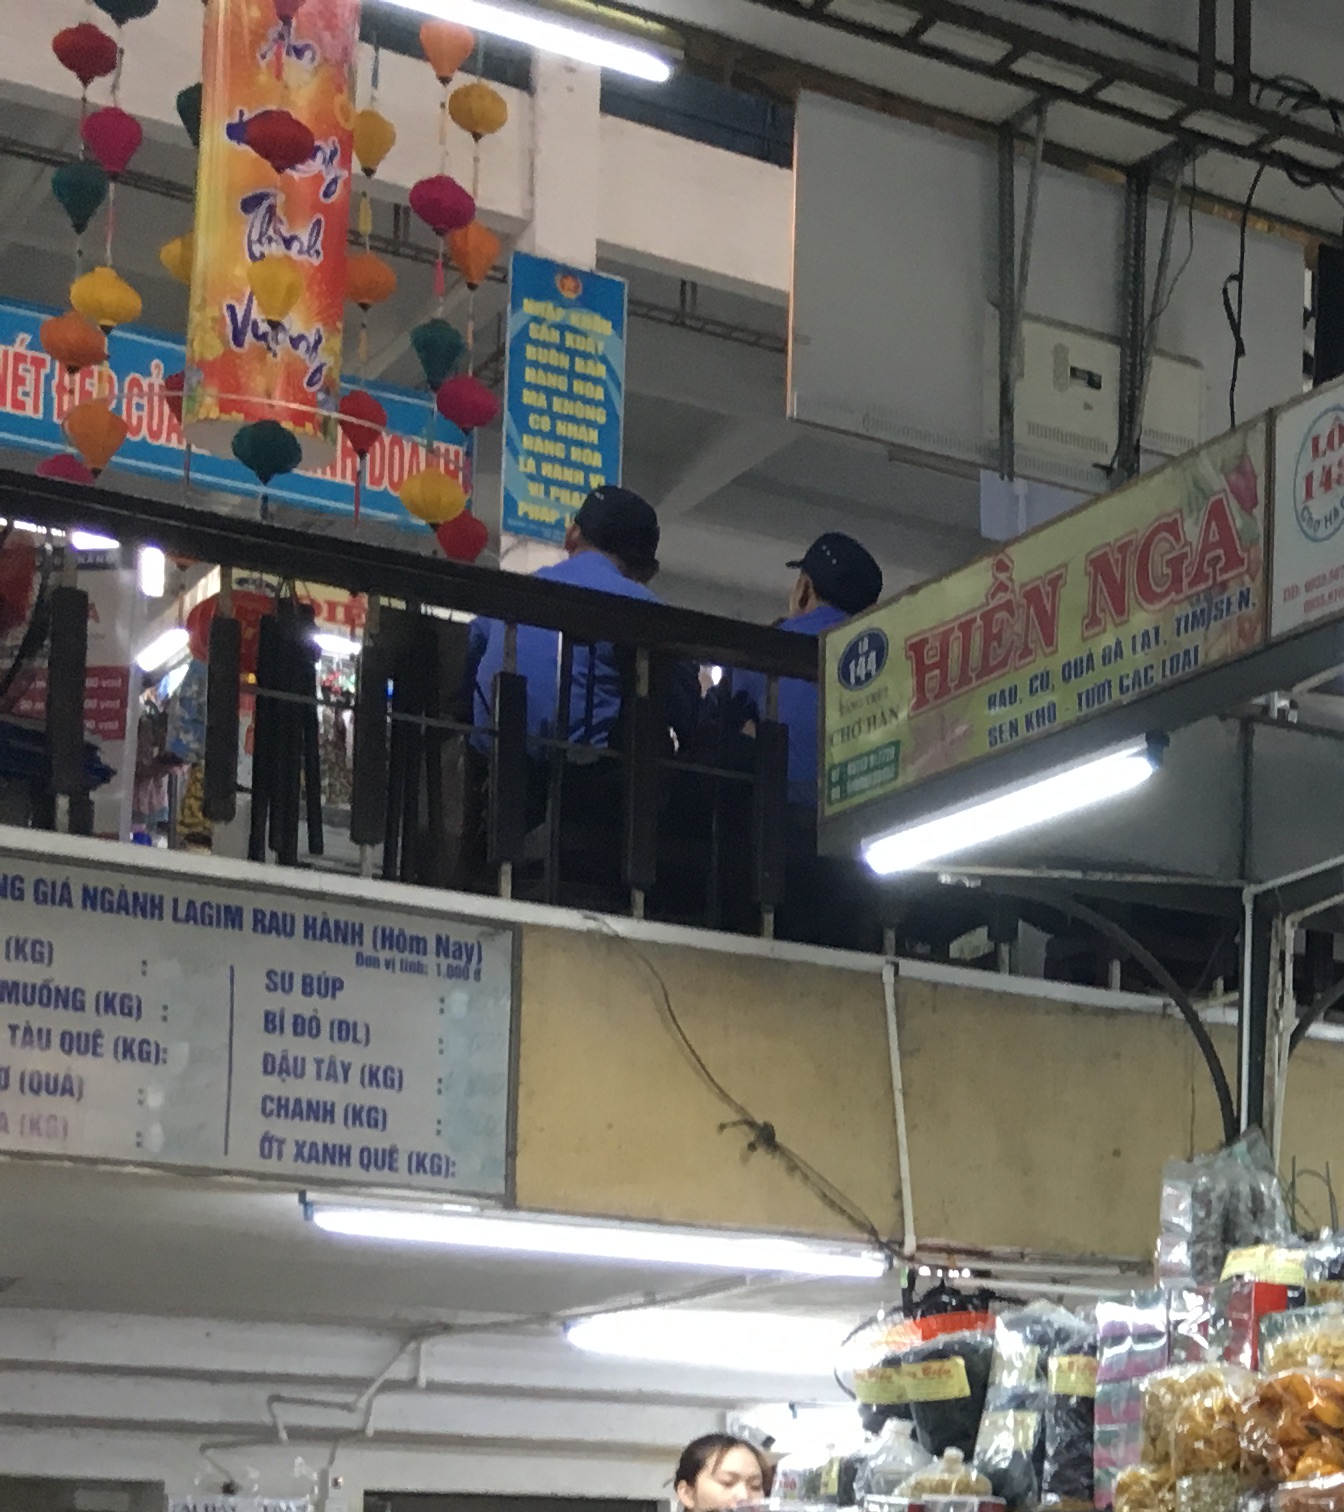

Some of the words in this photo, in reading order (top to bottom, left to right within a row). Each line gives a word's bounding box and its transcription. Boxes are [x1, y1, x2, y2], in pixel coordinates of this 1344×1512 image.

[905, 552, 1068, 717] HIỀN
[1081, 488, 1248, 640] NGA
[848, 650, 878, 686] 144
[988, 717, 1019, 748] SEN
[1024, 701, 1058, 734] KHÔ
[33, 876, 75, 909] GIÁ
[81, 883, 165, 922] NGÀNH
[171, 896, 245, 932] LAGIM
[251, 906, 296, 939] RAU
[303, 911, 365, 947] HÀNH
[372, 924, 429, 958] (Hôm
[435, 932, 484, 966] Nay)
[4, 935, 55, 967] (KG)
[264, 968, 295, 995] SU
[301, 970, 346, 1000] BÚP
[94, 989, 144, 1023] (KG)
[263, 1006, 286, 1037] BÍ
[292, 1007, 322, 1039] ĐỎ
[8, 1019, 53, 1052] TÀU
[59, 1028, 106, 1058] QUÊ
[313, 1054, 353, 1085] TÂY
[359, 1062, 405, 1094] (KG)
[19, 1112, 69, 1141] (KG)
[260, 1094, 337, 1126] CHANH
[343, 1102, 389, 1133] (KG)
[258, 1130, 288, 1162] ỚT
[294, 1138, 353, 1168] XANH
[358, 1142, 401, 1174] QUÊ
